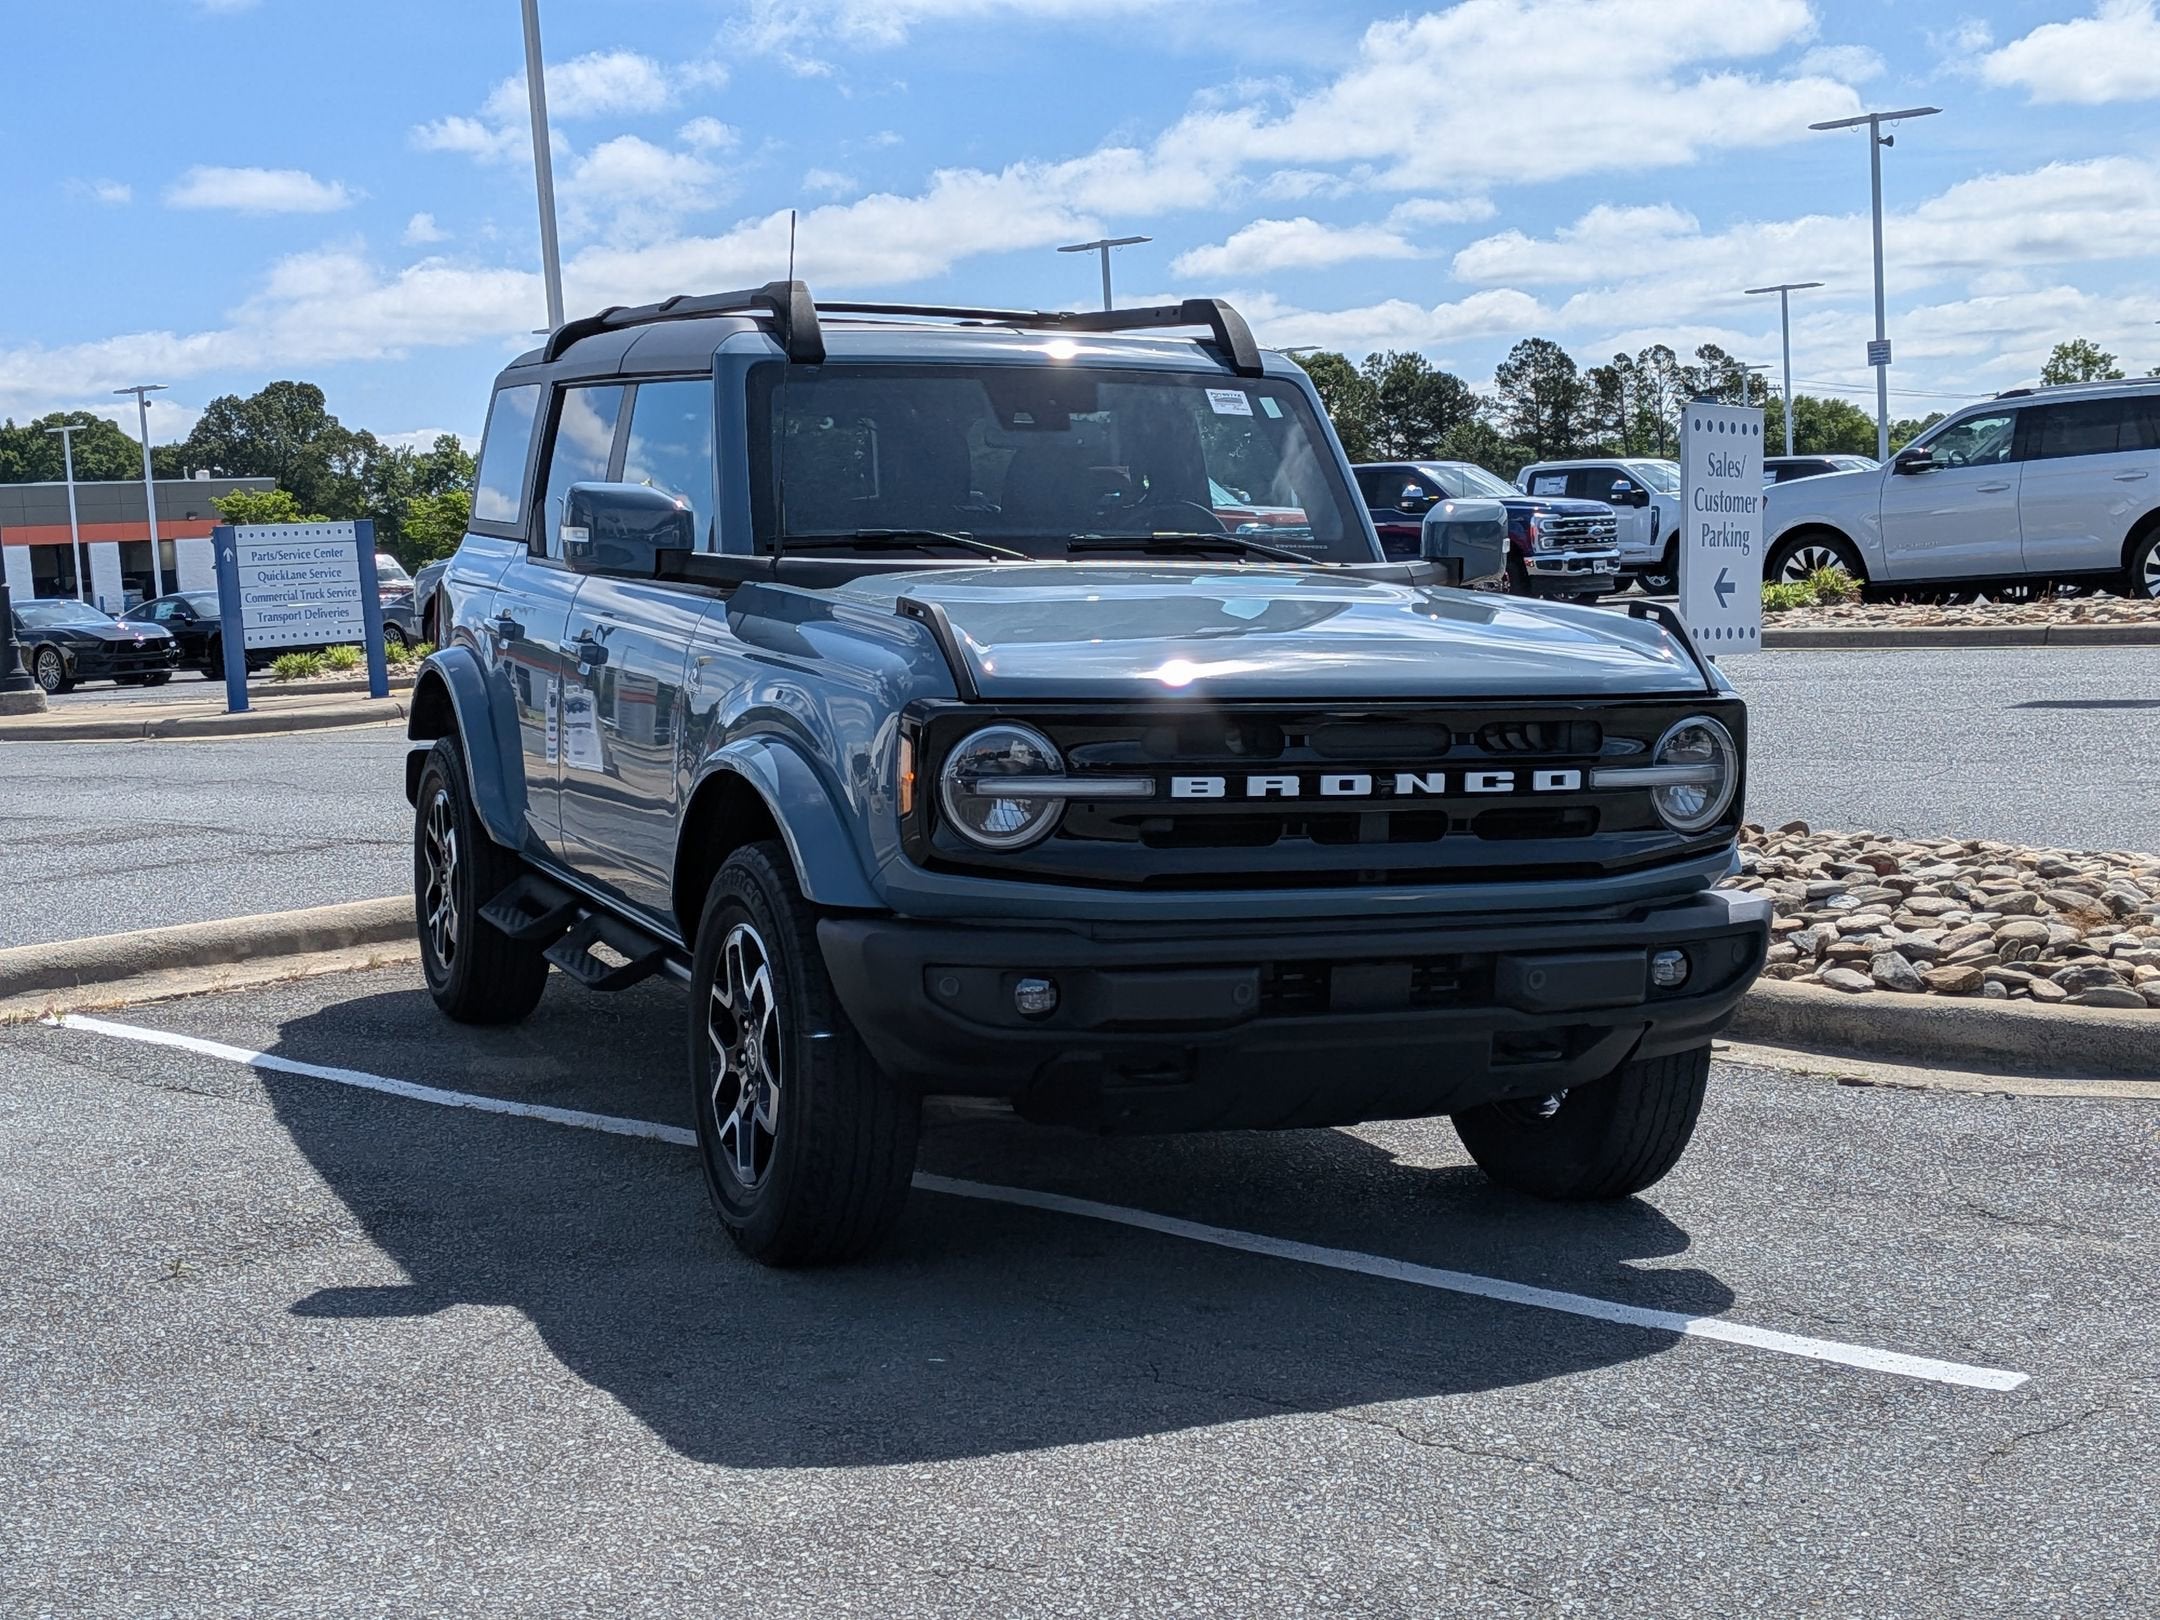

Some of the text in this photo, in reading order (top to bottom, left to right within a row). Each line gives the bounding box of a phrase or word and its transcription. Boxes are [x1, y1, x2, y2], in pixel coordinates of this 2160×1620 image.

[1707, 452, 1747, 479] Sales/
[1694, 487, 1758, 514] Customer
[1701, 521, 1751, 556] Parking
[251, 548, 344, 562] Parts/Service Center
[257, 567, 342, 582] QuickLane Service
[245, 587, 358, 604] Commercial Truck Service
[257, 607, 350, 624] Transport Deliveries
[1171, 770, 1581, 798] BRONCO
